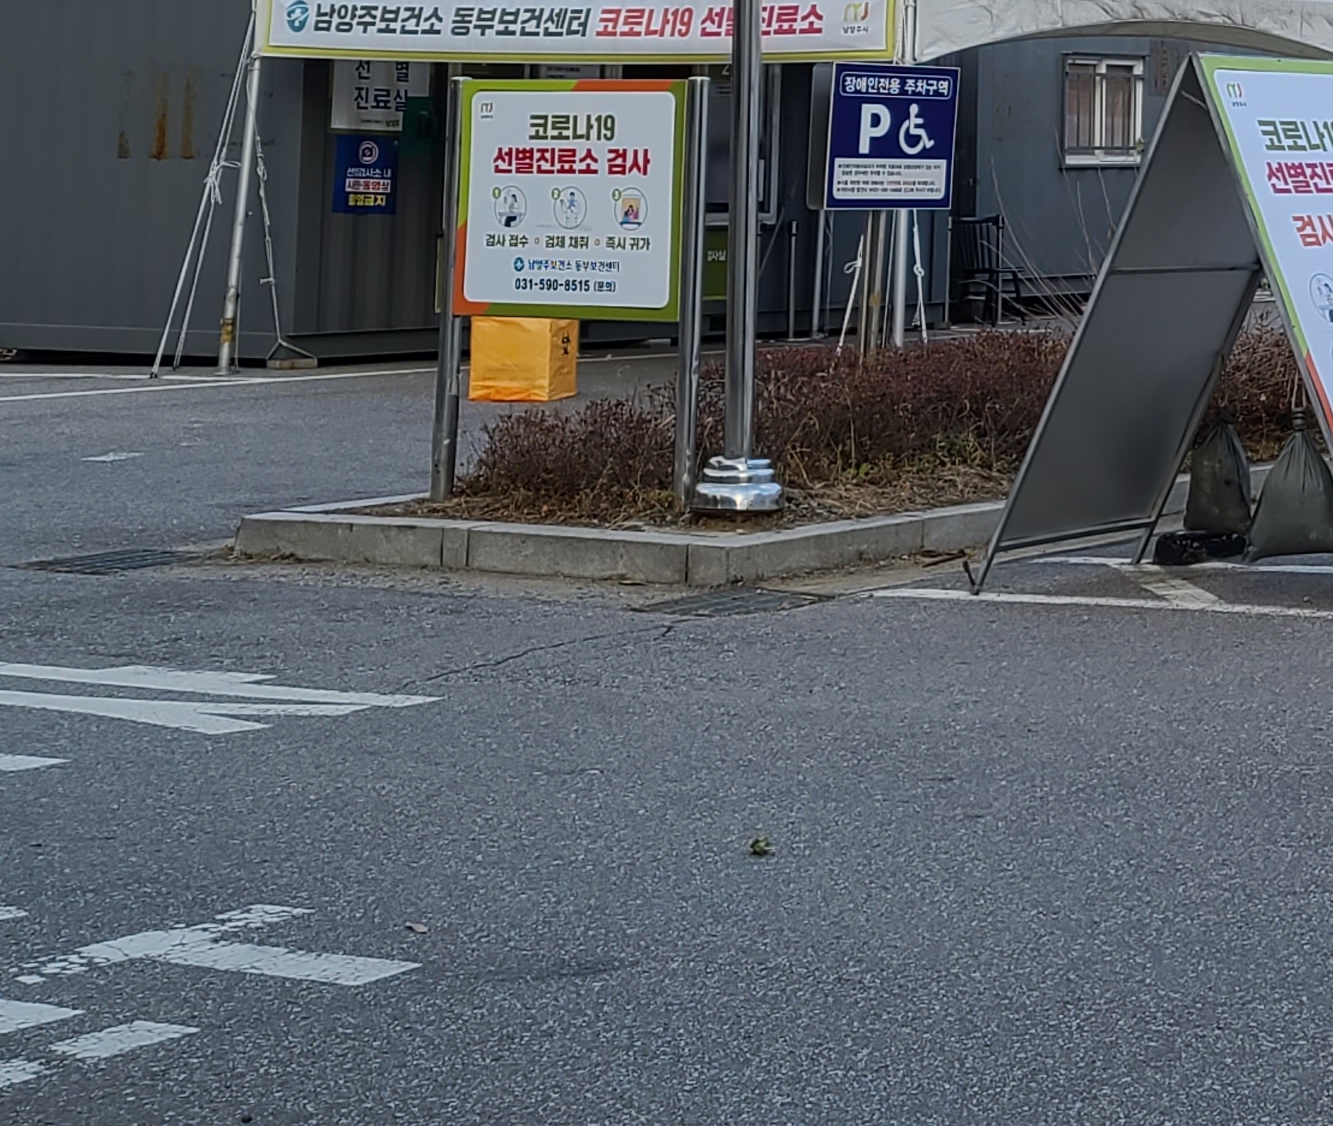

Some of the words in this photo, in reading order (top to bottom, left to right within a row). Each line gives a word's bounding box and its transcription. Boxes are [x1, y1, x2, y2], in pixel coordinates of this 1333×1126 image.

[313, 3, 444, 36] 남양주보건소
[450, 6, 592, 38] 동부보건센터
[595, 7, 695, 38] 코로나19
[700, 3, 824, 38] 선진료소
[844, 76, 901, 95] 장애인전용
[904, 78, 949, 96] 주차구역
[354, 86, 409, 113] 진료실
[528, 114, 616, 142] 코로나19
[858, 103, 891, 154] P
[493, 147, 599, 175] 선별진료소
[606, 148, 651, 176] 검사
[485, 234, 506, 247] 검사
[508, 234, 529, 248] 접수
[545, 235, 565, 249] 검체
[568, 235, 590, 250] 채취
[605, 236, 626, 251] 즉시
[629, 237, 651, 251] 귀가
[514, 277, 590, 292] 031-590-8515
[593, 280, 616, 293] (문의)
